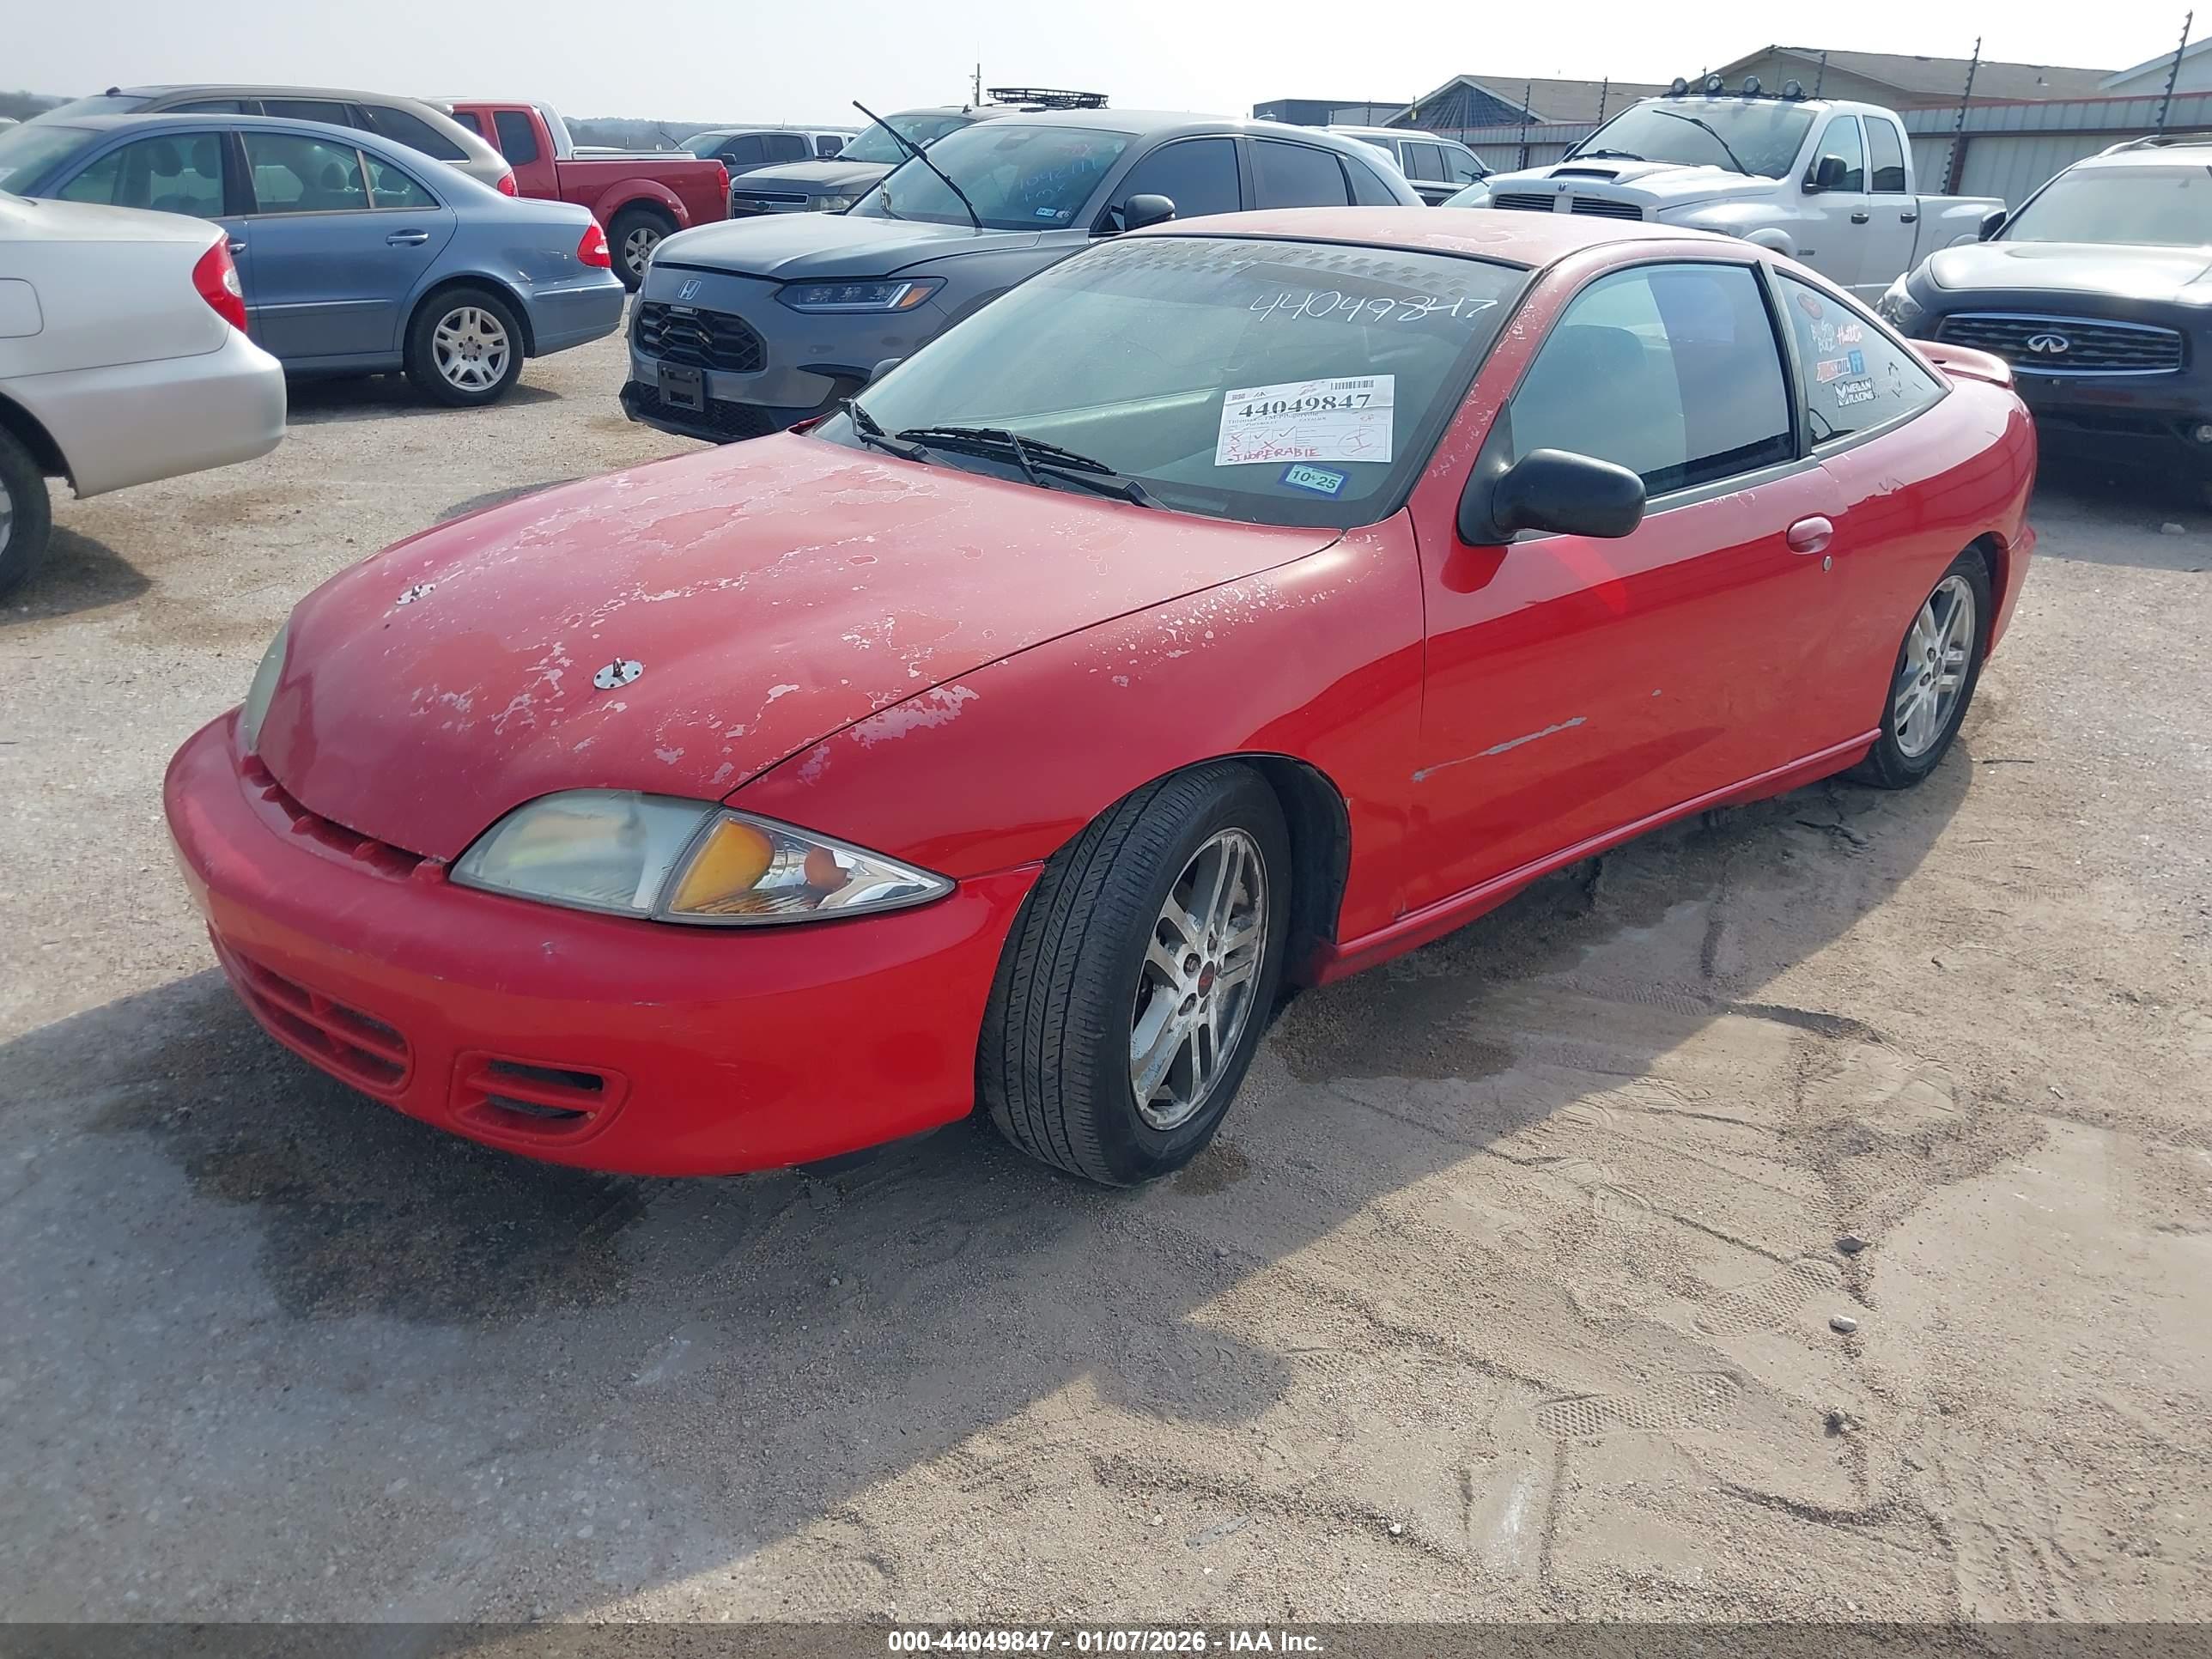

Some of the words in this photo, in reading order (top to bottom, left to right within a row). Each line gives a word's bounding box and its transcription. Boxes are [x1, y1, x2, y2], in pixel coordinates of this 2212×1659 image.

[1249, 290, 1498, 322] 44049847
[1845, 380, 1872, 392] MEGAN
[1238, 392, 1372, 418] 44049847
[1848, 391, 1875, 404] RACING
